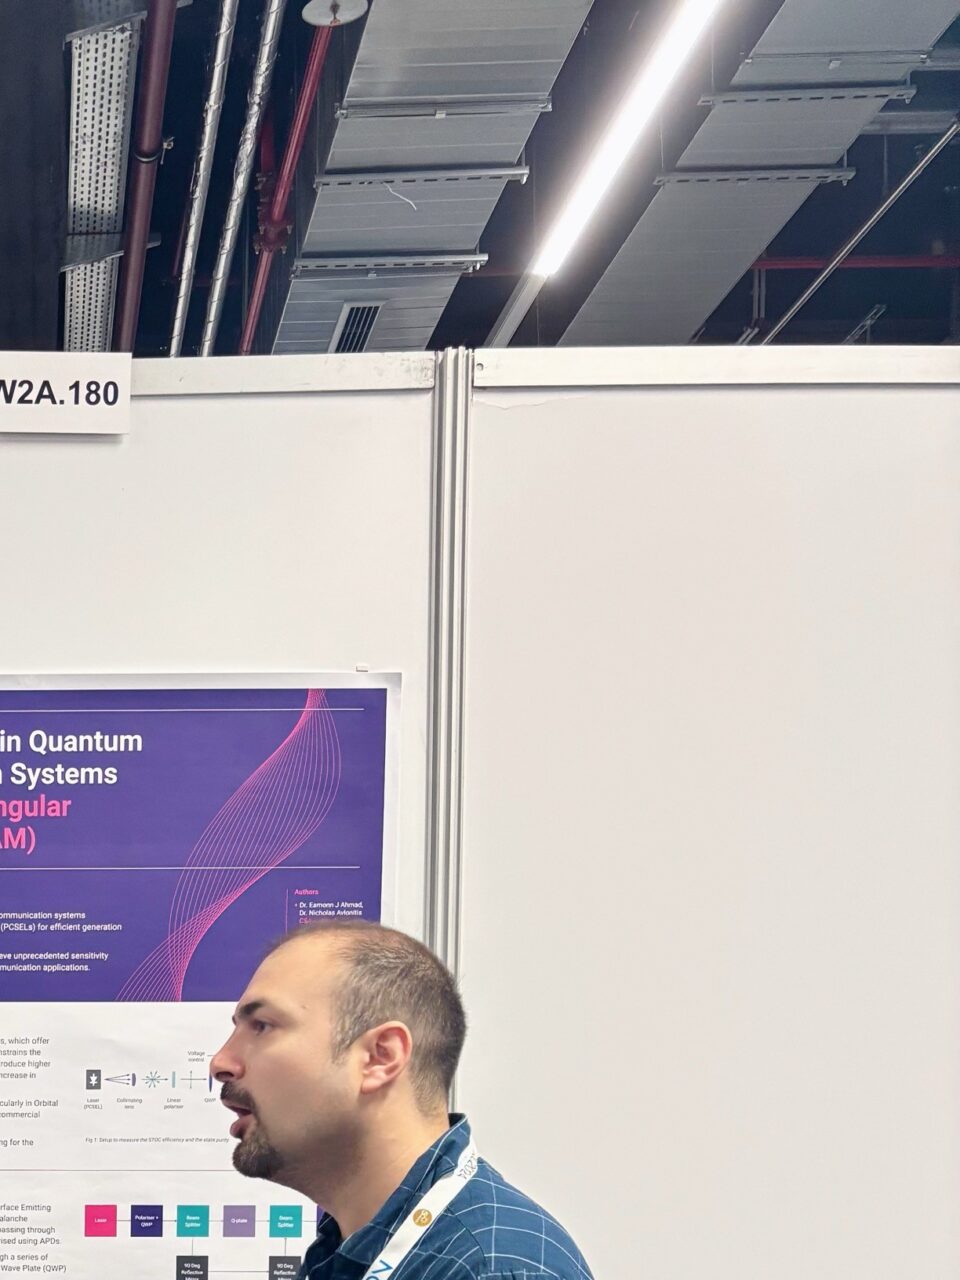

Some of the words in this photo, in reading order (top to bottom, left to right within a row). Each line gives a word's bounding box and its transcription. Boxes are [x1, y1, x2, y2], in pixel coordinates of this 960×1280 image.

[0, 730, 21, 752] in
[29, 730, 143, 755] Quantum
[10, 762, 118, 790] Systems
[54, 912, 86, 921] systems
[0, 923, 36, 932] (PCSELs)
[37, 923, 49, 931] for
[50, 922, 81, 931] efficient
[82, 923, 123, 932] generation
[13, 952, 70, 961] unprecedented
[71, 952, 109, 961] sensitivity
[43, 963, 91, 972] applications.
[31, 1036, 50, 1045] offer
[27, 1060, 51, 1069] higher
[27, 1226, 56, 1235] through
